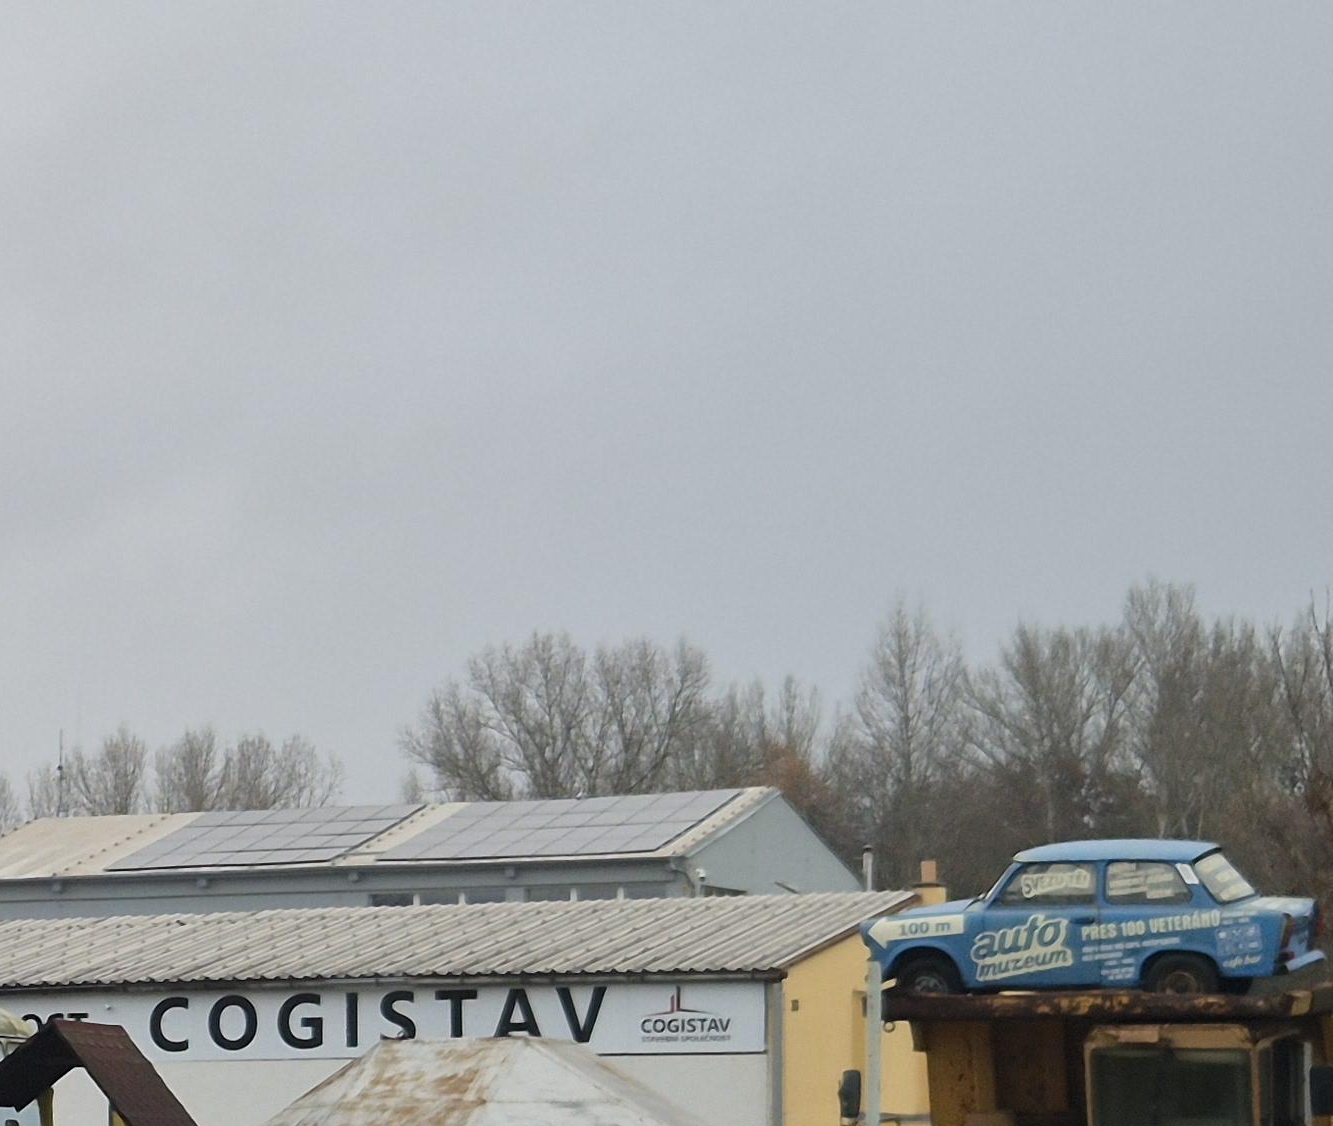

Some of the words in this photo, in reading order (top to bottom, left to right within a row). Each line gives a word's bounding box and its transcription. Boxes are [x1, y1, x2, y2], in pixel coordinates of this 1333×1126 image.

[898, 921, 930, 936] 100
[935, 922, 952, 934] m
[972, 914, 1069, 960] auto
[1121, 920, 1146, 937] 100
[975, 948, 1072, 980] muzeum
[148, 985, 609, 1053] COGISTAV
[640, 1018, 731, 1034] COGISTAV
